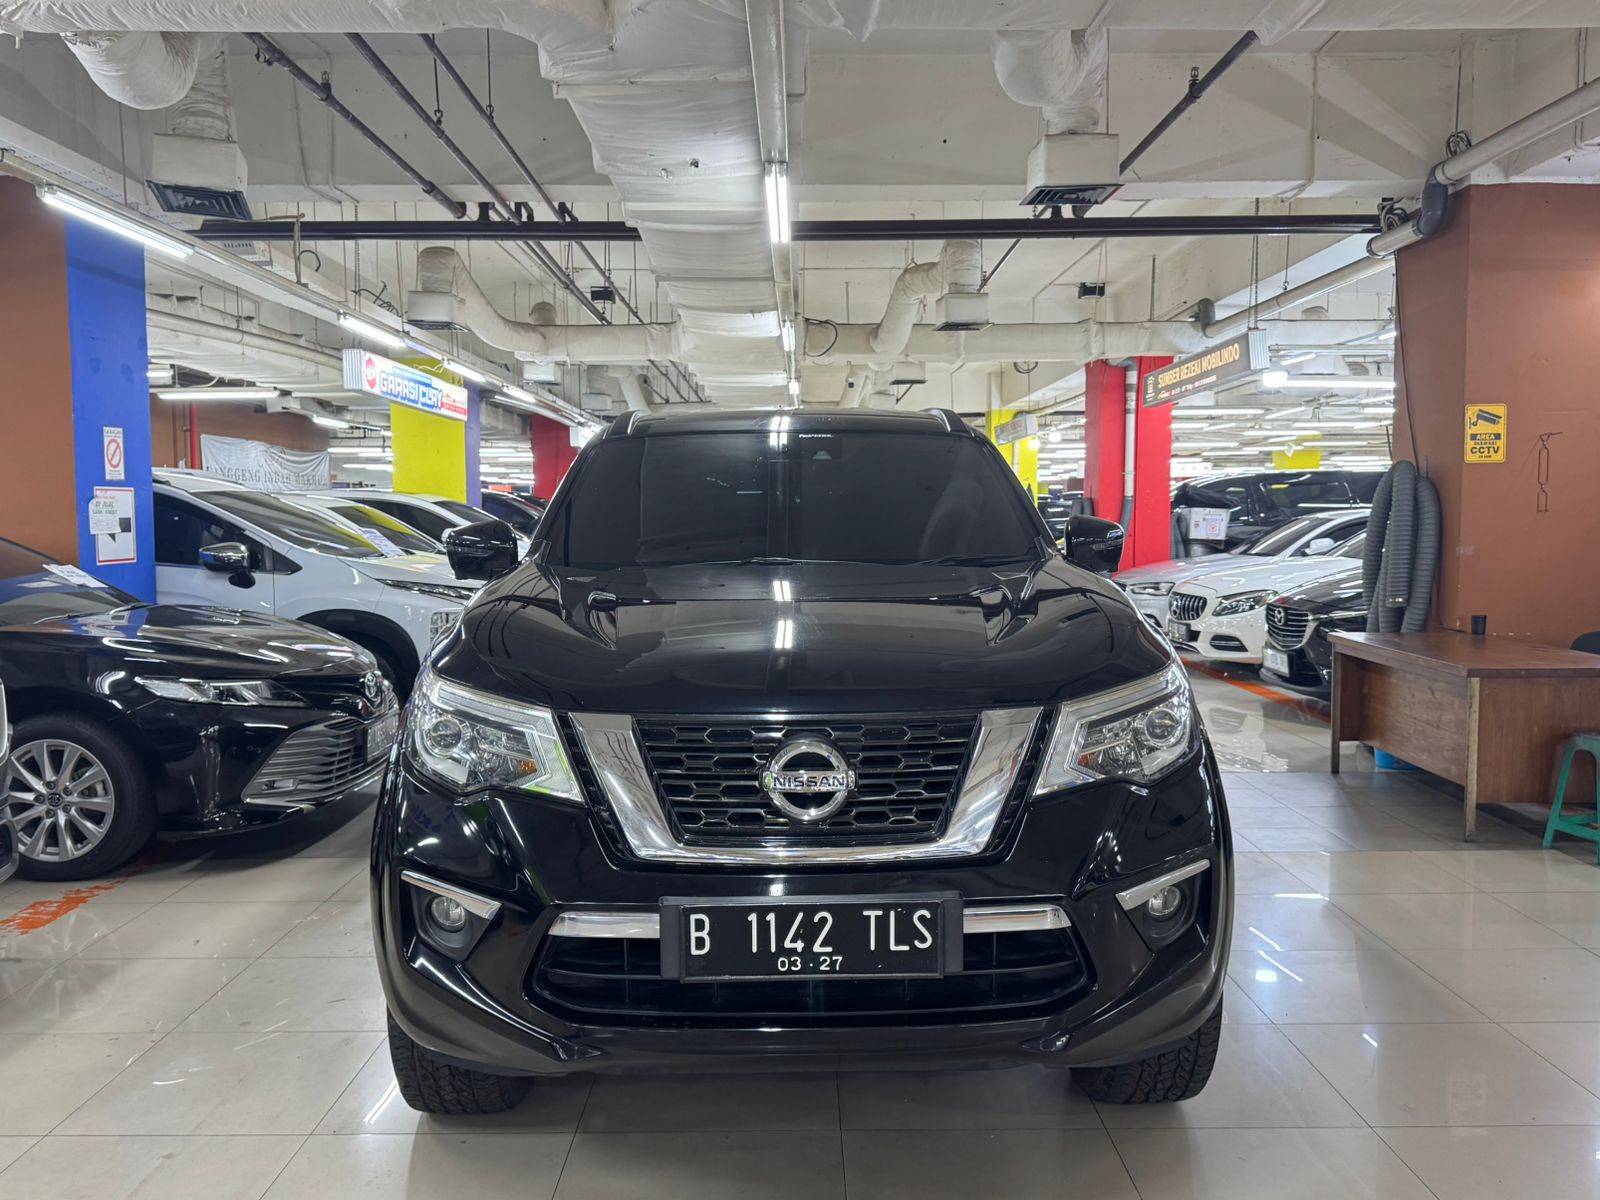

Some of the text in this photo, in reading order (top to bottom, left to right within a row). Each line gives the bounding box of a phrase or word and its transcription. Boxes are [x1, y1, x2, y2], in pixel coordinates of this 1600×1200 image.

[1158, 368, 1180, 388] SUMBER
[1180, 359, 1201, 379] REZEKI
[1202, 343, 1240, 372] MOBILINDO
[380, 372, 419, 402] GARASI
[1471, 446, 1499, 454] CCTV
[773, 775, 845, 788] NISSAN
[689, 909, 933, 956] B 1142 TLS
